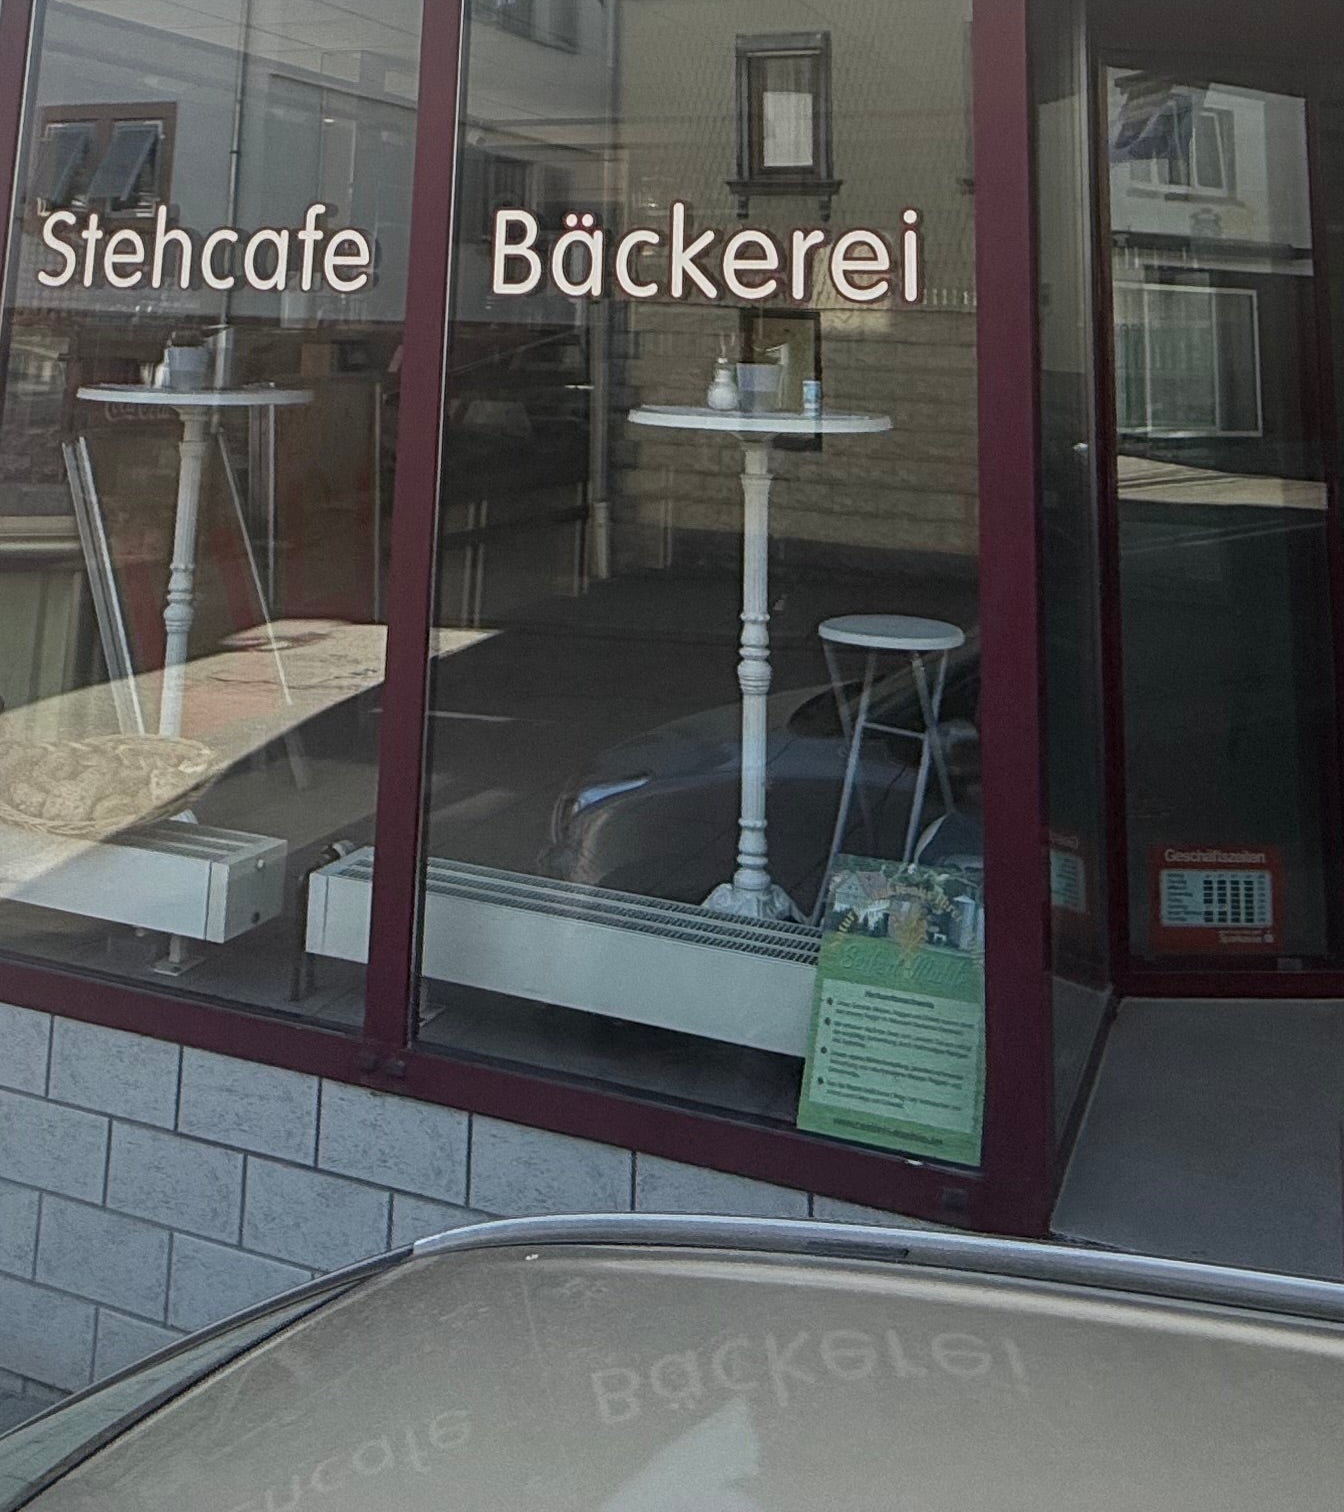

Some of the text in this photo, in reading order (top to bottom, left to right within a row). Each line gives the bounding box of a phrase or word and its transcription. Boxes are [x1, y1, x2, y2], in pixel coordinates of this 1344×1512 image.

[38, 204, 371, 292] Stehcafe
[492, 201, 922, 304] Bäckerei
[1164, 848, 1266, 863] Geschäftszeiten
